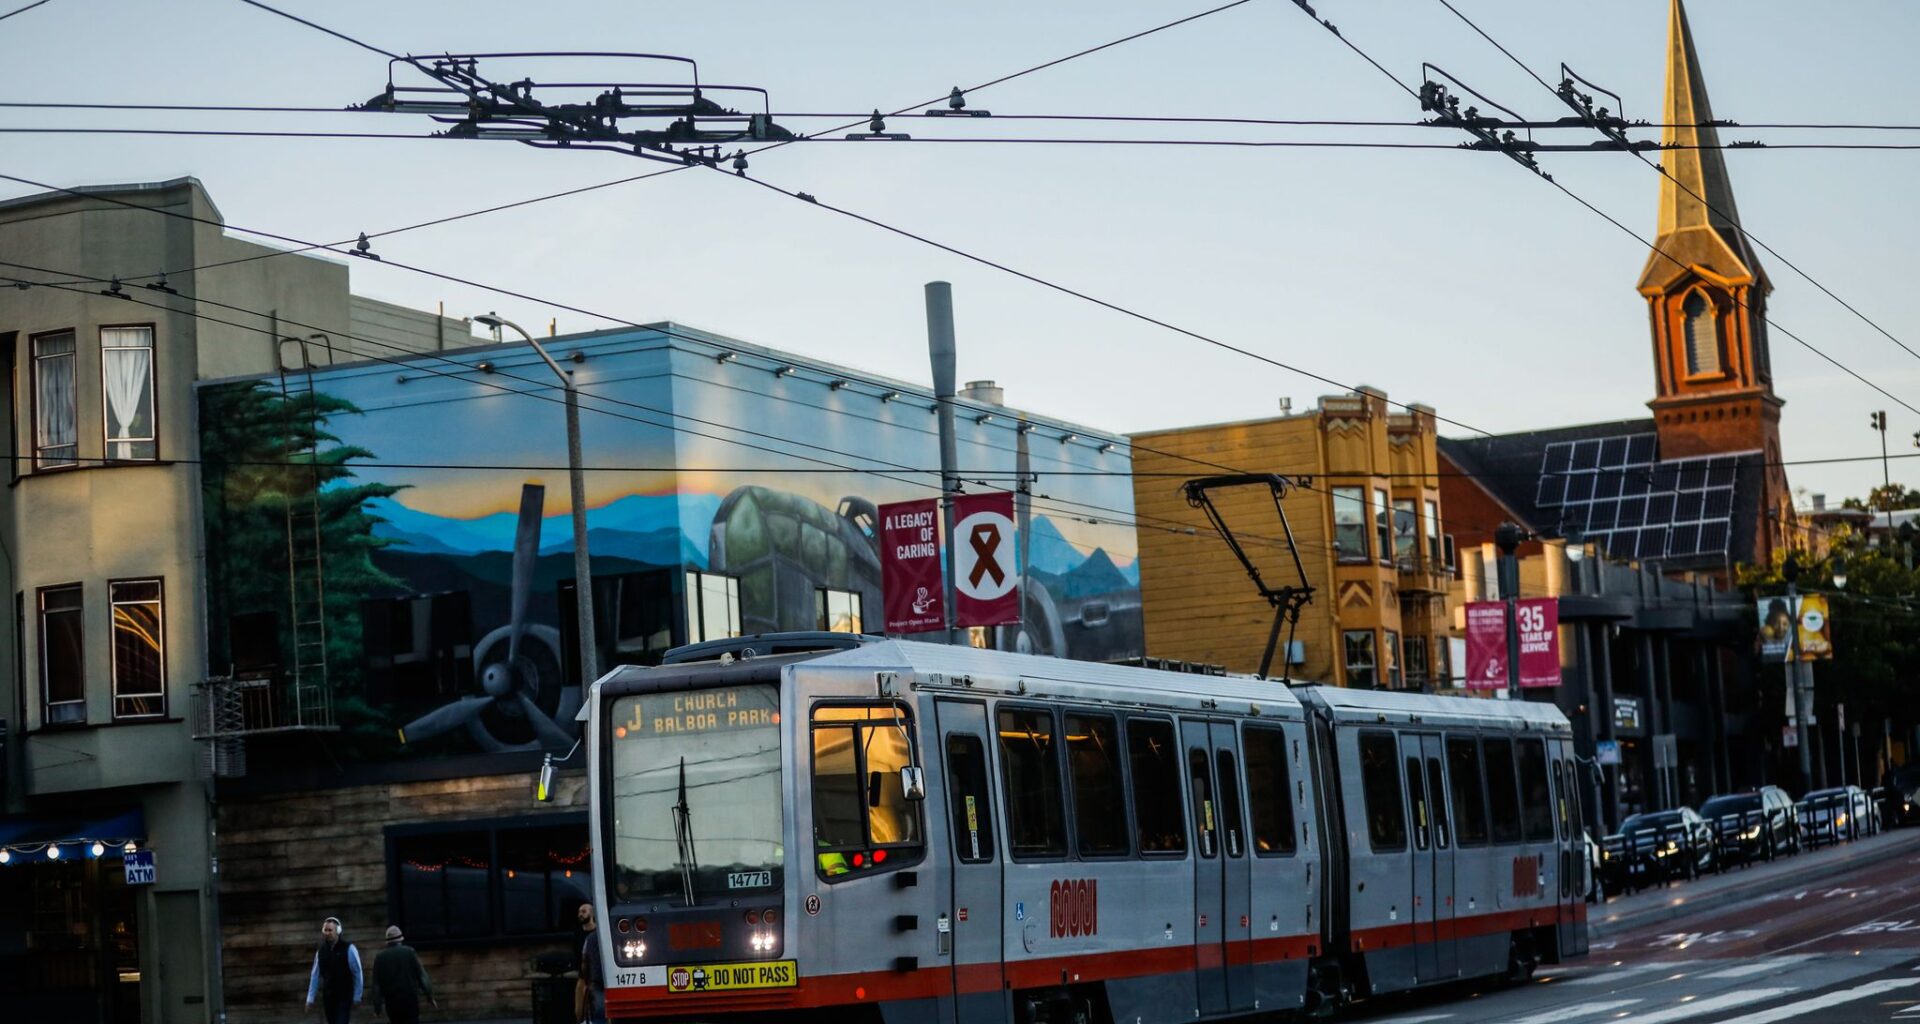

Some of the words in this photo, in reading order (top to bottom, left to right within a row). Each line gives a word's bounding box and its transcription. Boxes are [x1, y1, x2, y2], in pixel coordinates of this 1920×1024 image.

[885, 516, 893, 531] A
[895, 511, 933, 529] LEGACY
[920, 527, 934, 542] OF
[896, 543, 935, 560] CARING
[1519, 605, 1545, 632] 35
[1521, 631, 1543, 642] YEARS
[1543, 630, 1553, 641] OF
[1521, 642, 1549, 653] SERVICE
[674, 693, 737, 712] CHURCH
[627, 704, 642, 731] J
[654, 714, 717, 733] BALBOA
[728, 708, 770, 726] PARK
[128, 869, 154, 882] ATM
[616, 973, 636, 985] 1477
[640, 973, 646, 985] B
[672, 974, 690, 986] STOP
[714, 970, 730, 985] DO
[733, 968, 756, 985] NOT
[760, 966, 789, 983] PASS
